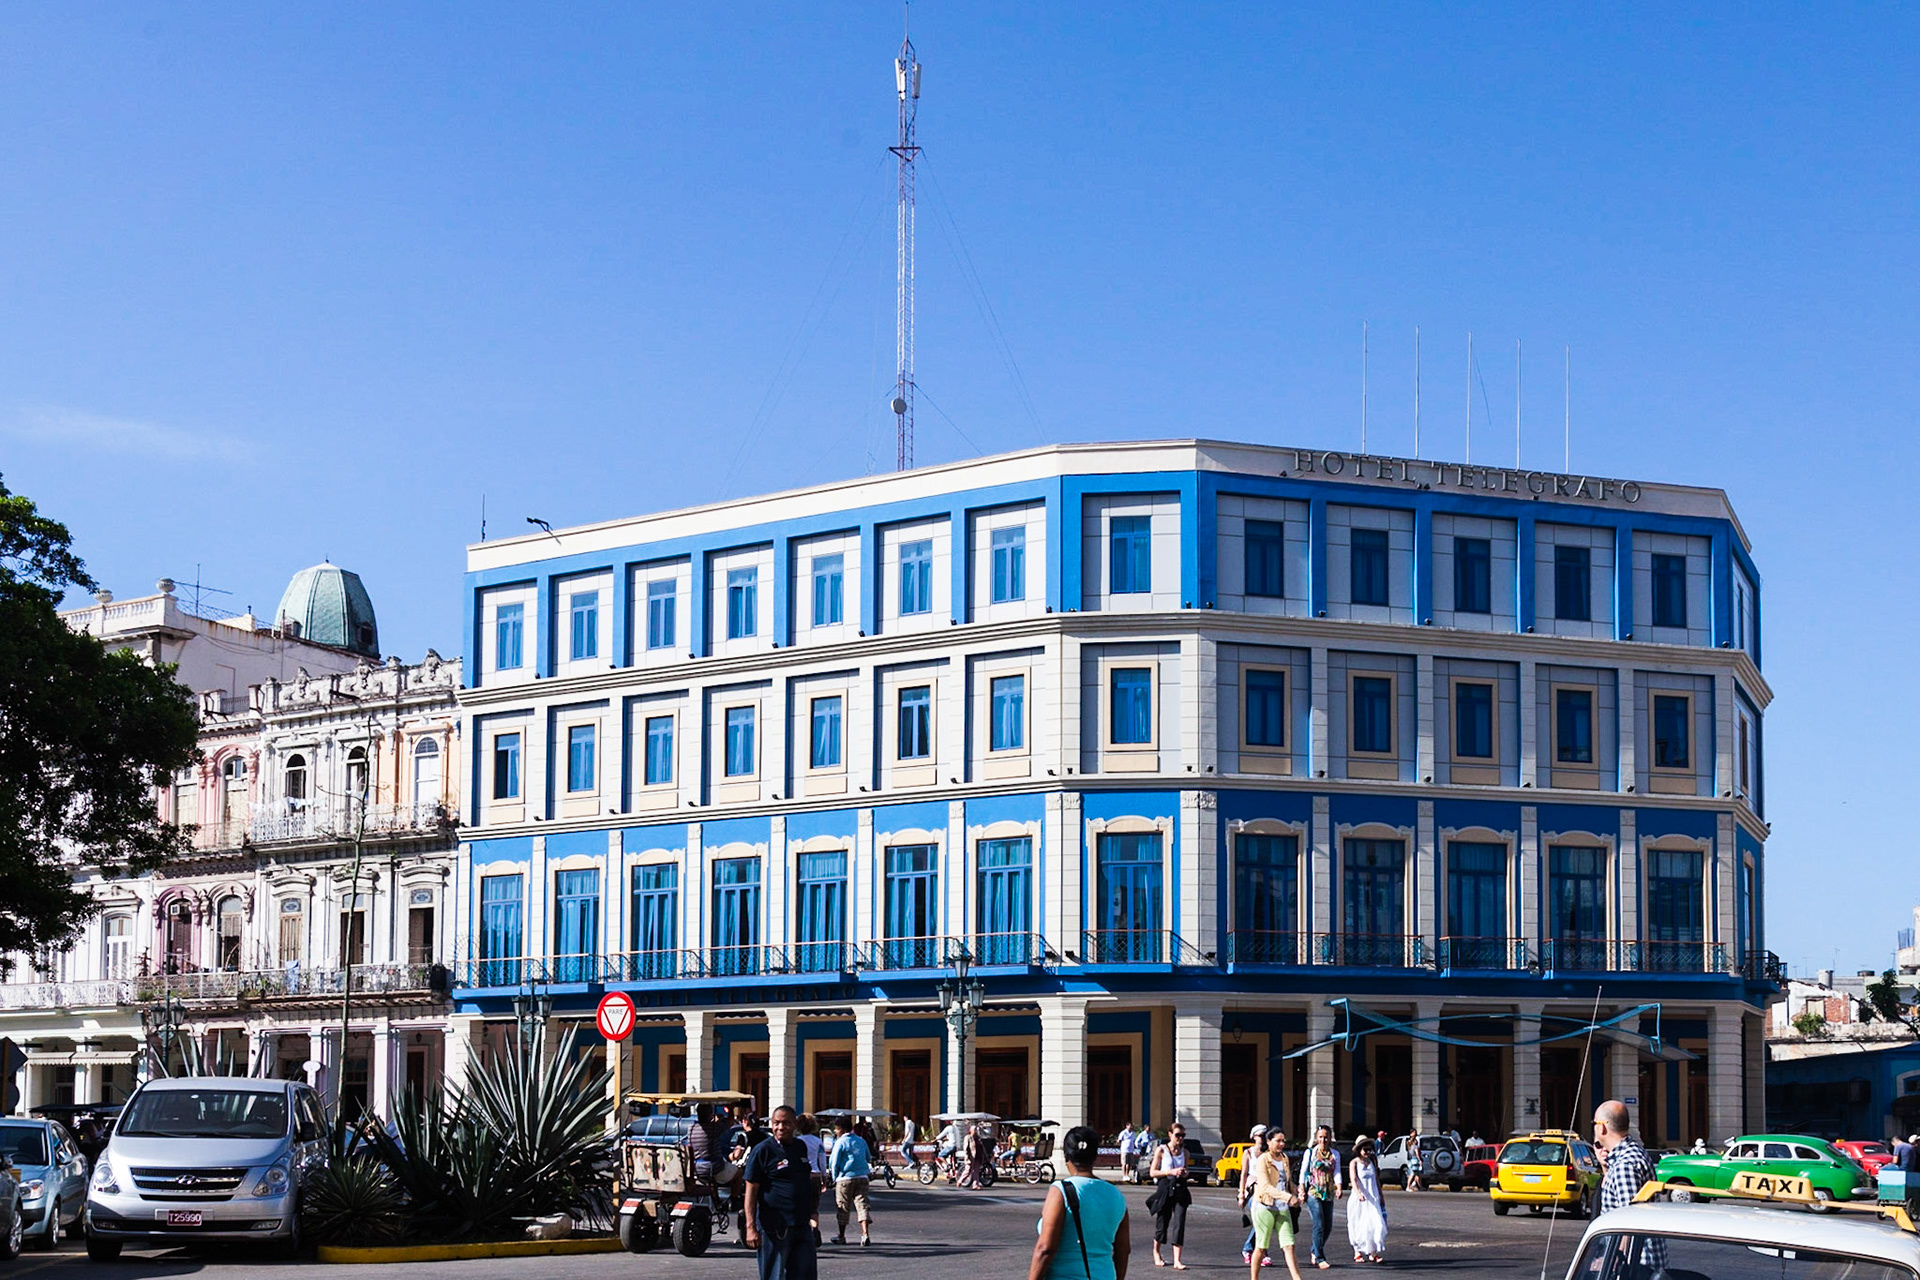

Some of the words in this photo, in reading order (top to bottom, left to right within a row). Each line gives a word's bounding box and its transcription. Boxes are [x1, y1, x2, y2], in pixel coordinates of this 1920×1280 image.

[1294, 449, 1416, 482] HOTEL
[1432, 461, 1642, 504] TELEGRAFO
[1742, 1175, 1803, 1194] TAXI
